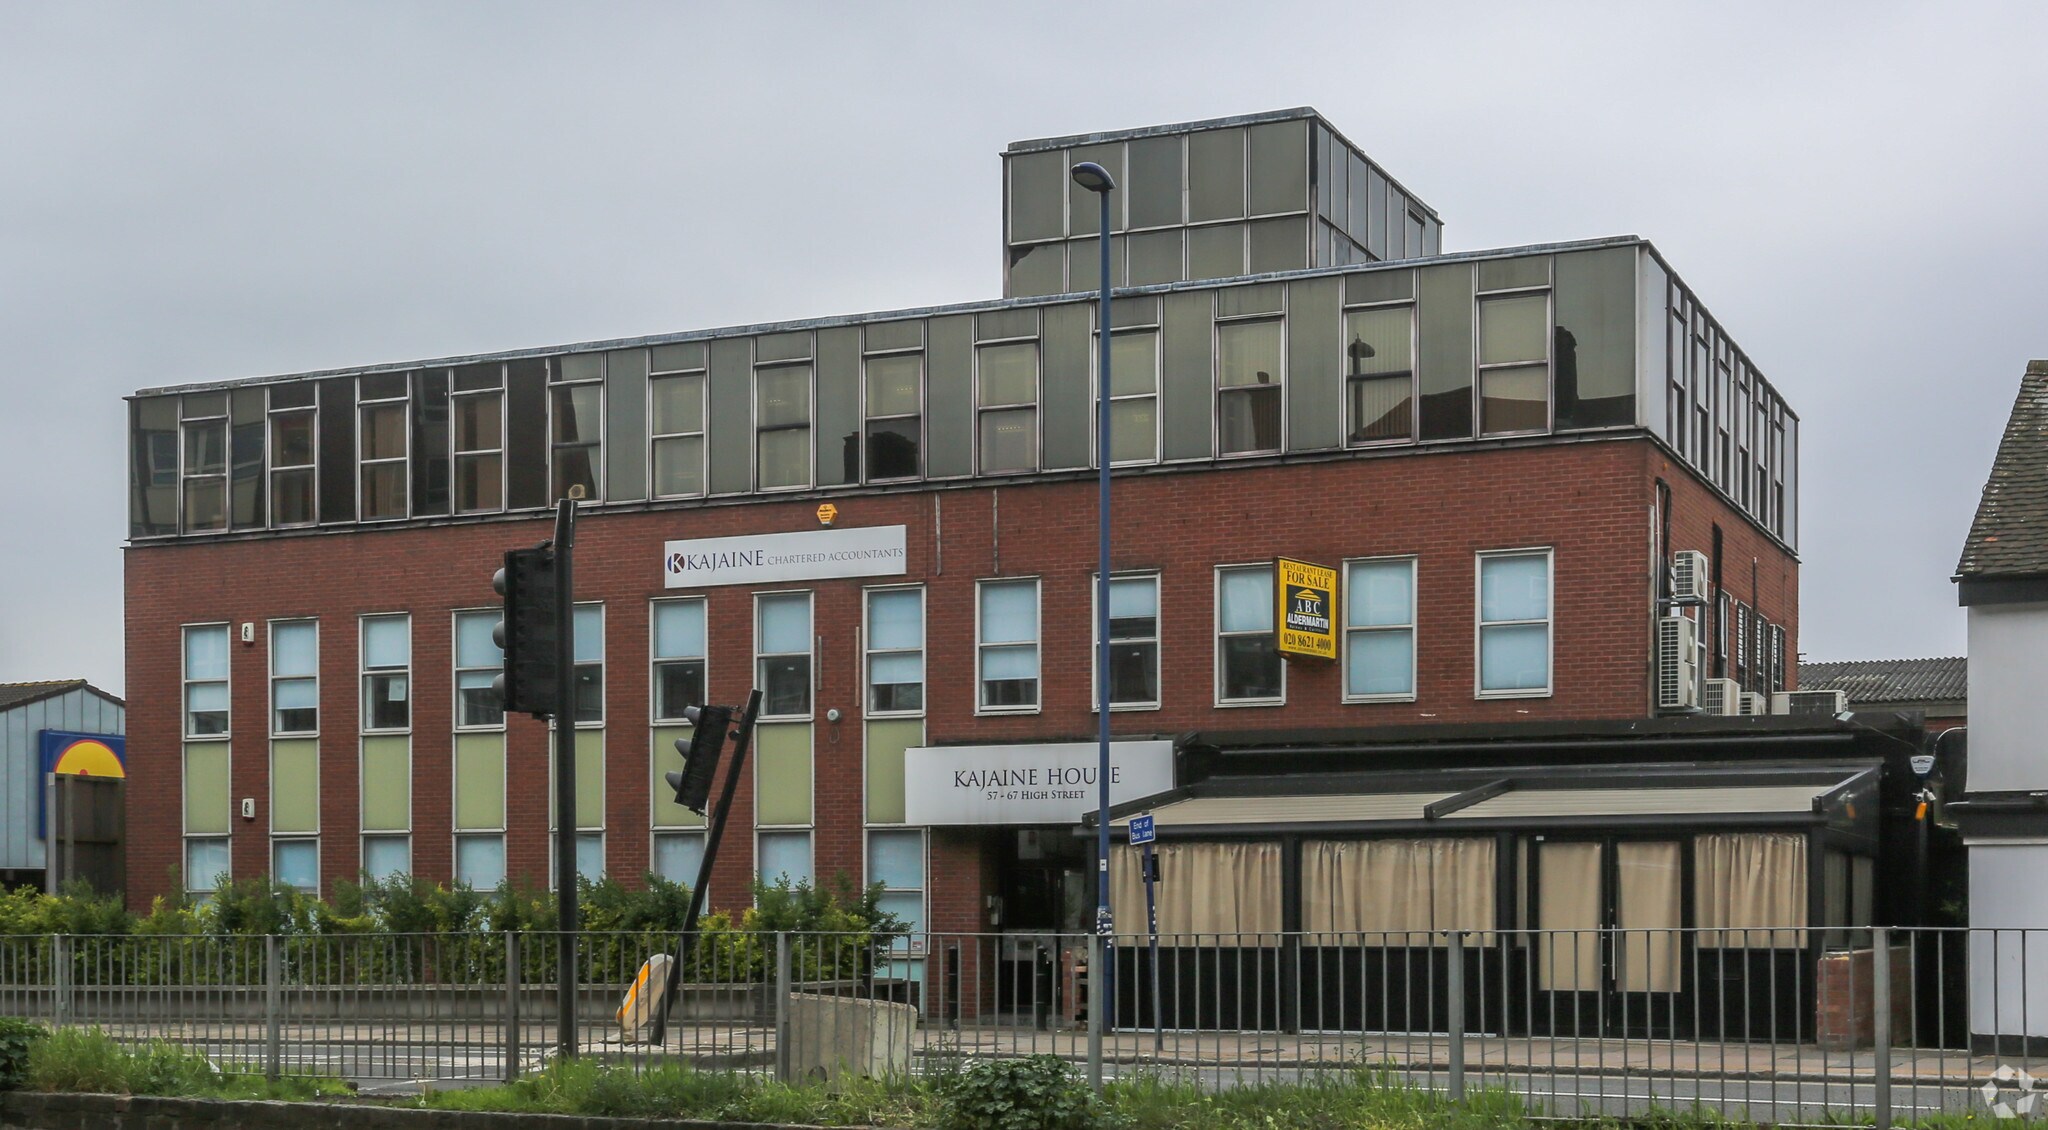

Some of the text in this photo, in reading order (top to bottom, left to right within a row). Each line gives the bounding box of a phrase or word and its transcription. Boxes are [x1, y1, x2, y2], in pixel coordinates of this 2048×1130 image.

[687, 550, 764, 573] KAJAINE
[767, 552, 826, 565] CHARTERED
[828, 548, 904, 562] ACCOUNTANTS
[1283, 562, 1332, 578] RESTAURANT LEASE
[1286, 570, 1330, 589] FOR SALE
[1284, 632, 1296, 645] 020
[1297, 635, 1314, 648] 8621
[954, 767, 1120, 791] KAJAINE HOUE
[987, 791, 998, 800] 57
[1007, 791, 1018, 800] 67
[1133, 819, 1149, 830] End of
[1131, 832, 1141, 840] Bus
